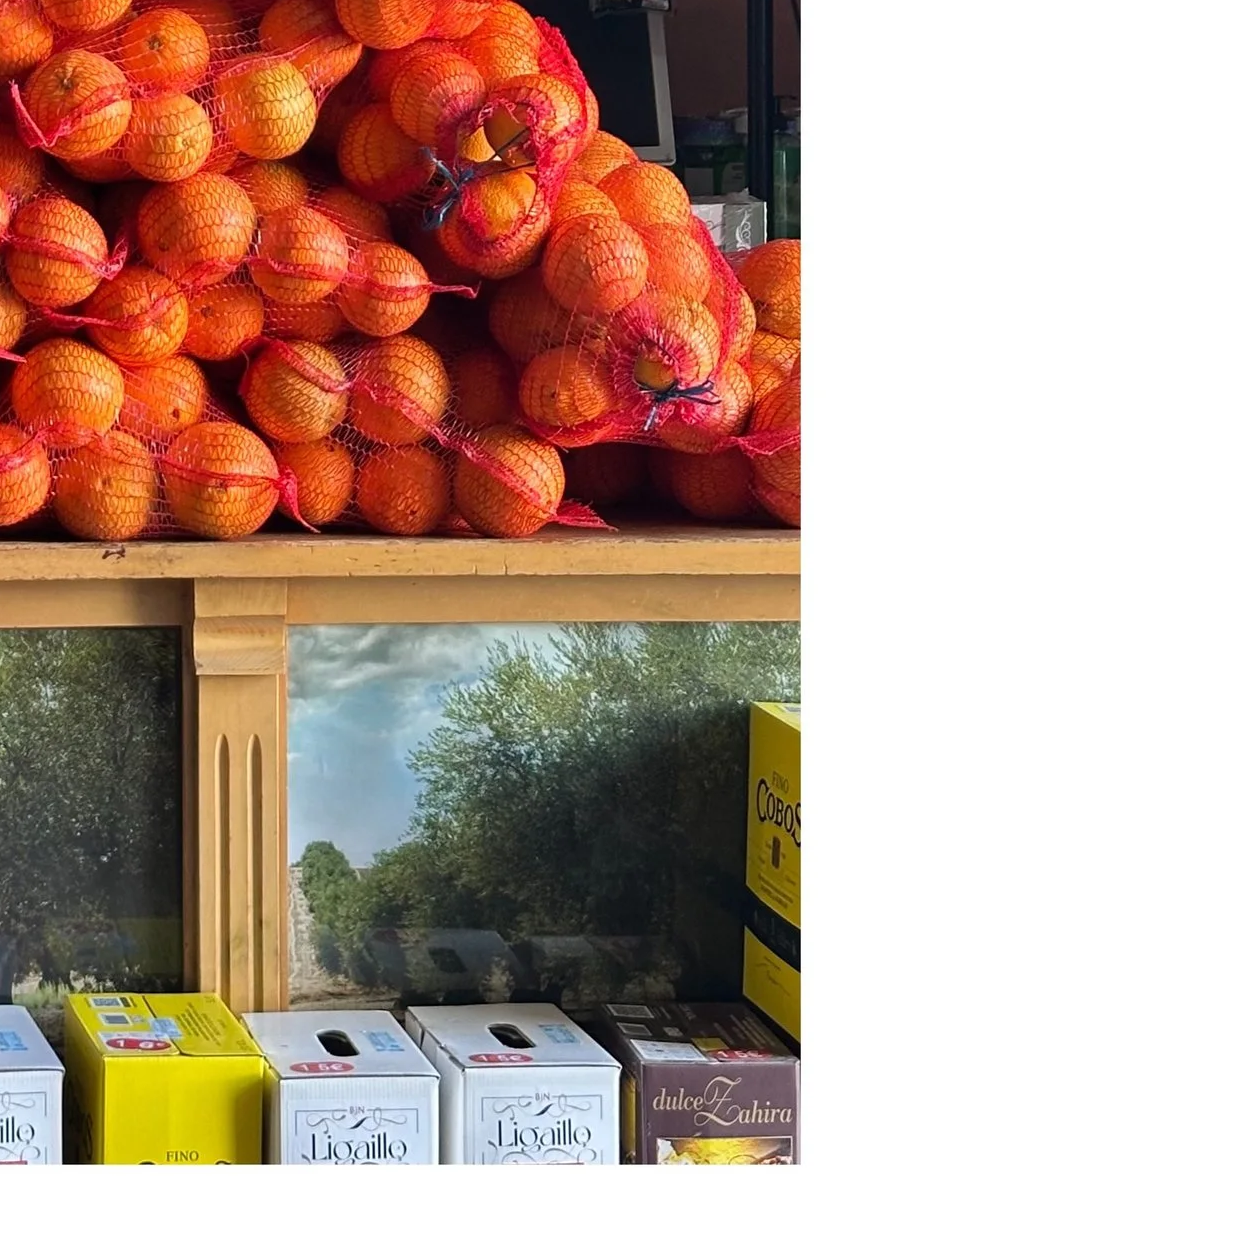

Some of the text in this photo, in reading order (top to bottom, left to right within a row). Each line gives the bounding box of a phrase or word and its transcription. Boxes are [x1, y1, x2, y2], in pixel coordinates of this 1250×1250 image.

[652, 1075, 793, 1127] dulce Zahira
[310, 1132, 408, 1164] Ligaillo
[496, 1119, 593, 1154] Ligaillo
[166, 1150, 199, 1162] FINO
